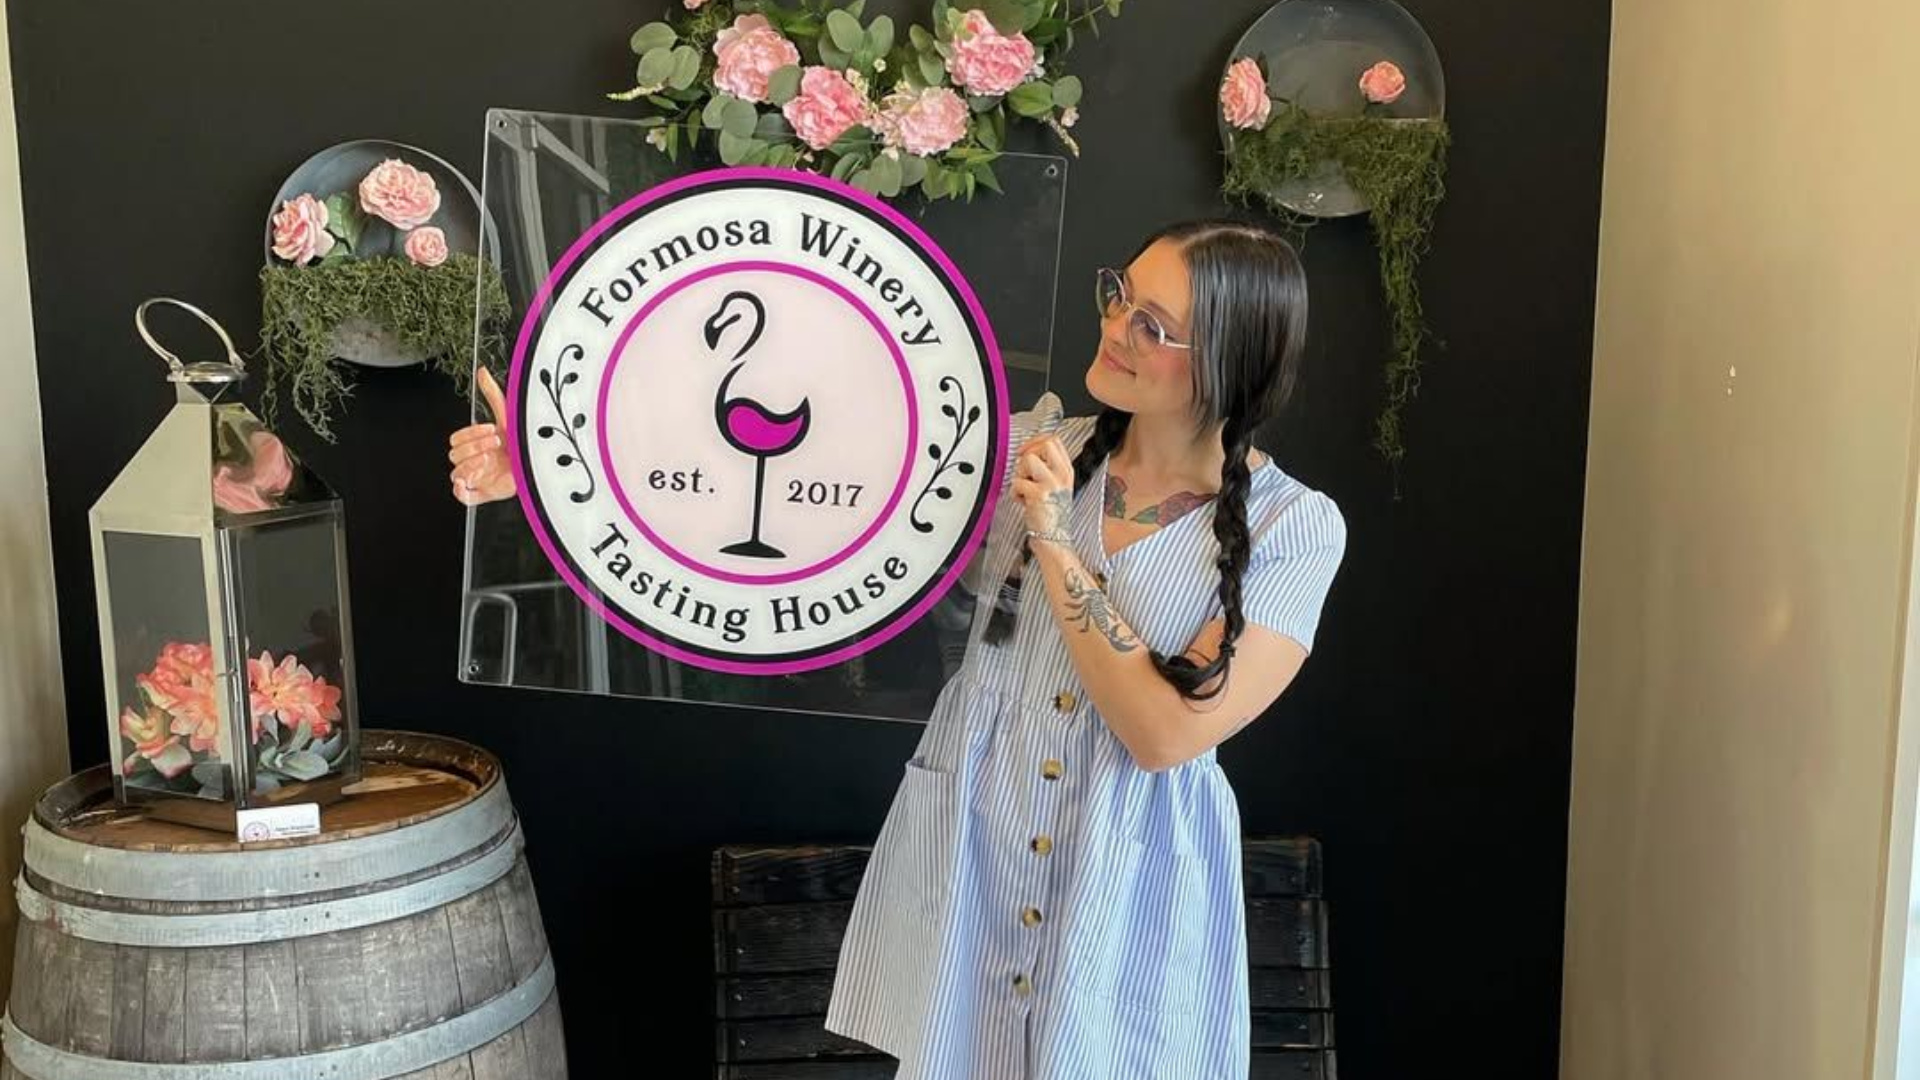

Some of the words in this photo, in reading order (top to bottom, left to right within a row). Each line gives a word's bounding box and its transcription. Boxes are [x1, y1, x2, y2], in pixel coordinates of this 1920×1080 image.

[579, 219, 772, 327] Formosa
[800, 212, 942, 348] Winery
[648, 468, 715, 493] est.
[787, 480, 864, 507] 2017
[590, 522, 750, 643] Tasting
[769, 555, 909, 634] House
